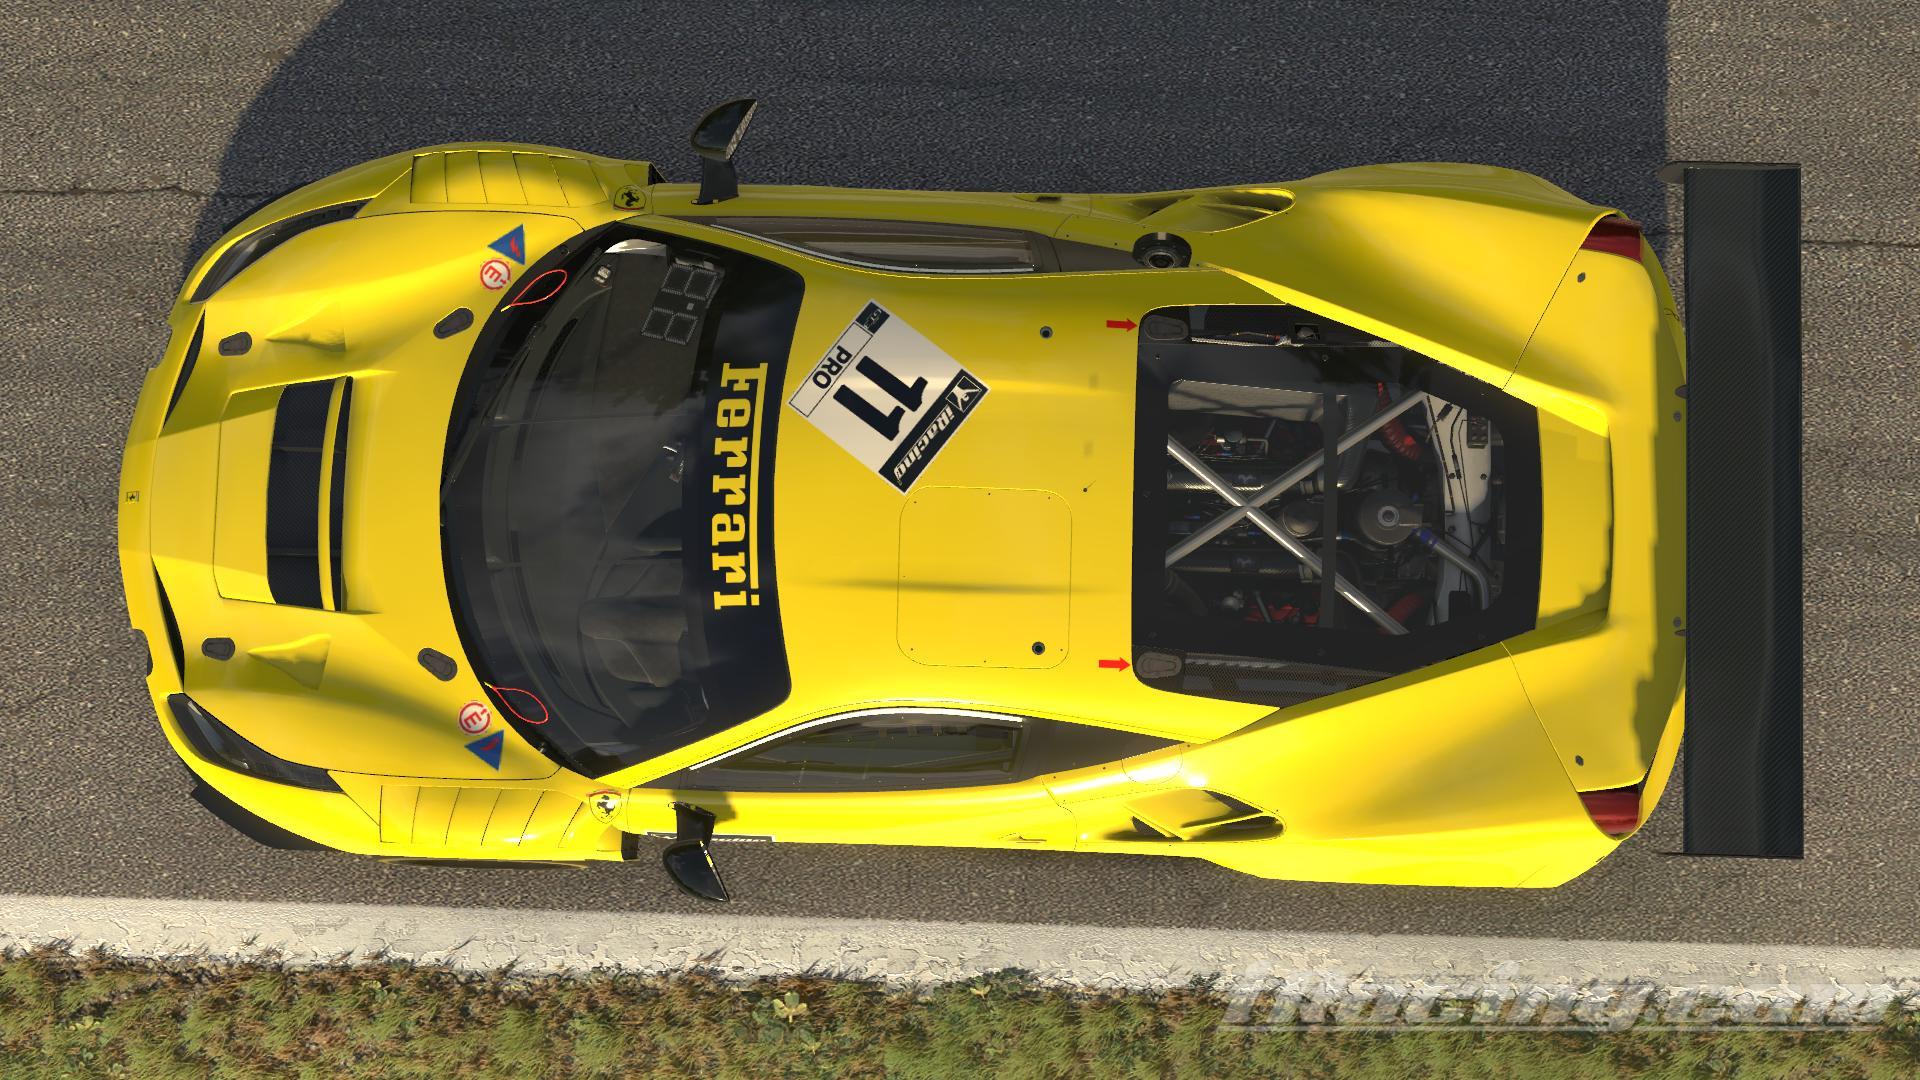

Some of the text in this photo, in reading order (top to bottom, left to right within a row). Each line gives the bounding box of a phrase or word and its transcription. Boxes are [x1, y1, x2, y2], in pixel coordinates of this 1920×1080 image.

[812, 345, 853, 390] PRO
[833, 355, 928, 442] 11
[893, 404, 956, 482] iRacing
[711, 362, 769, 610] Ferrari
